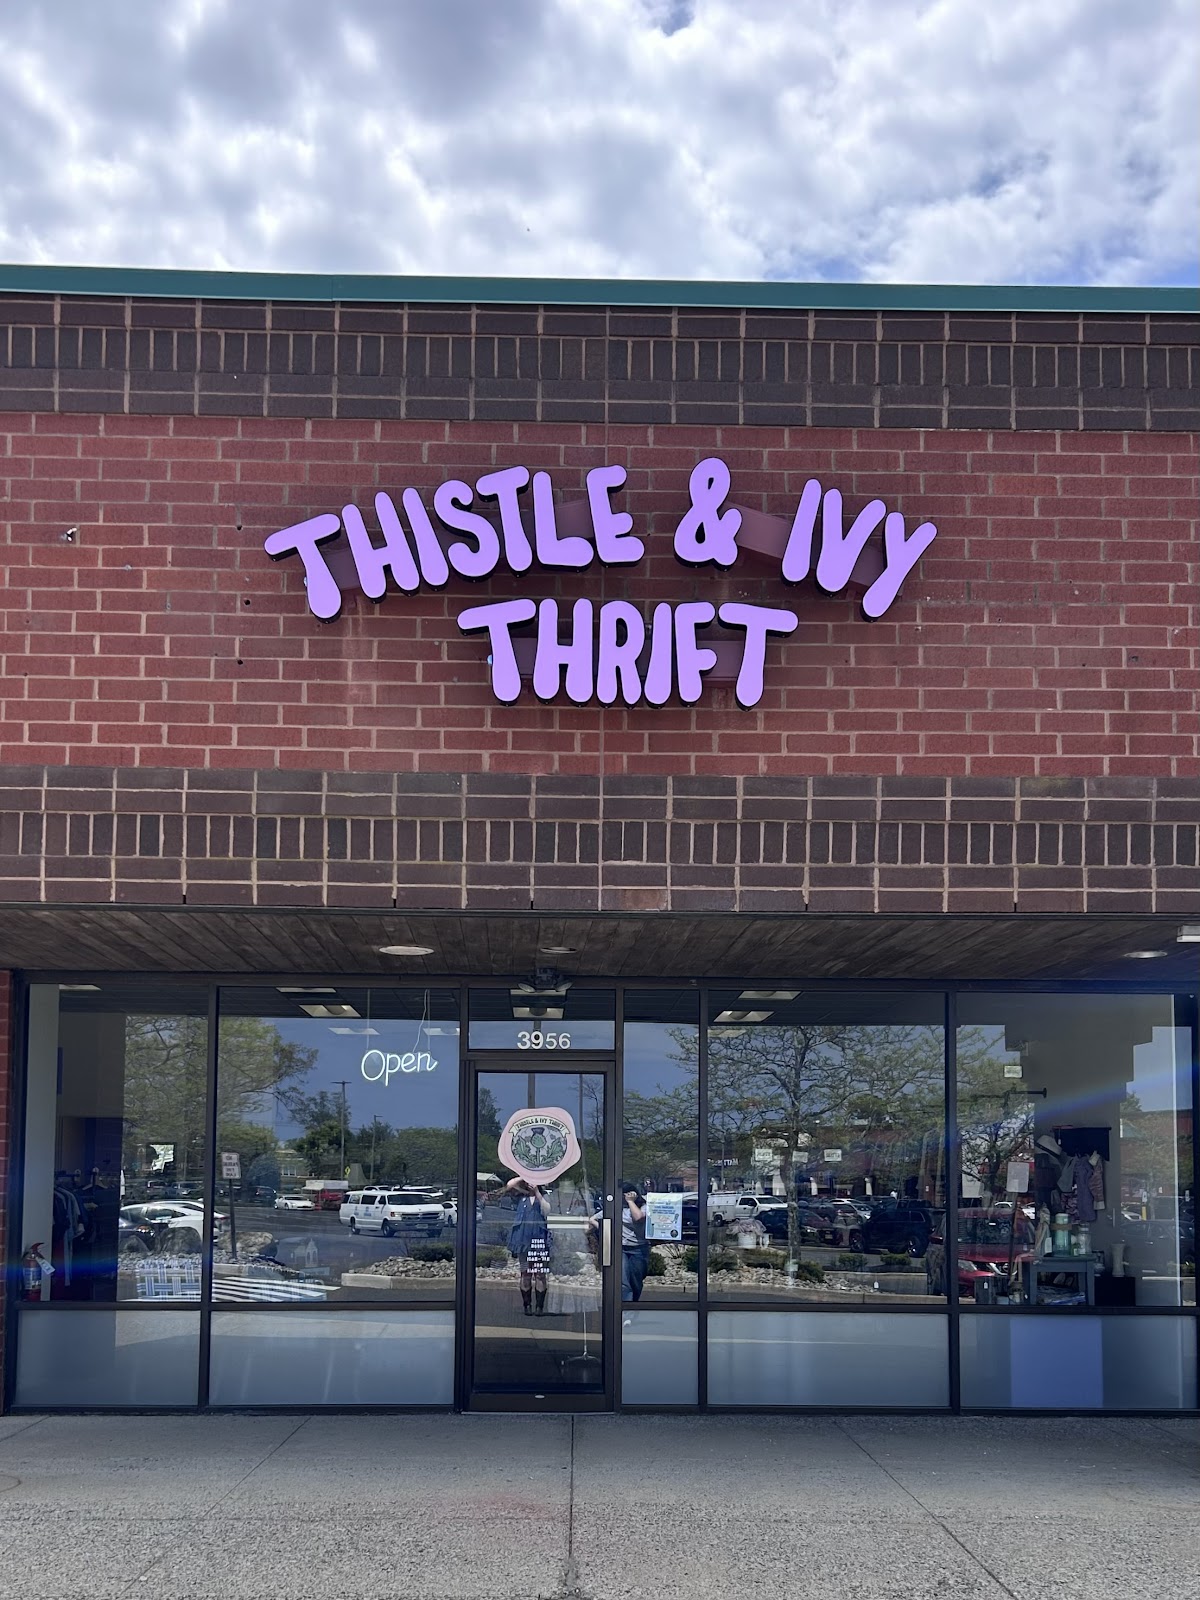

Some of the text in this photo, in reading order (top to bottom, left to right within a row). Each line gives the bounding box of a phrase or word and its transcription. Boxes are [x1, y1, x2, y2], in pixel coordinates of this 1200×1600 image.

[263, 456, 938, 622] THISTLE & IVY
[456, 597, 799, 708] THRIFT
[361, 1049, 438, 1087] Open
[516, 1031, 571, 1050] 3956
